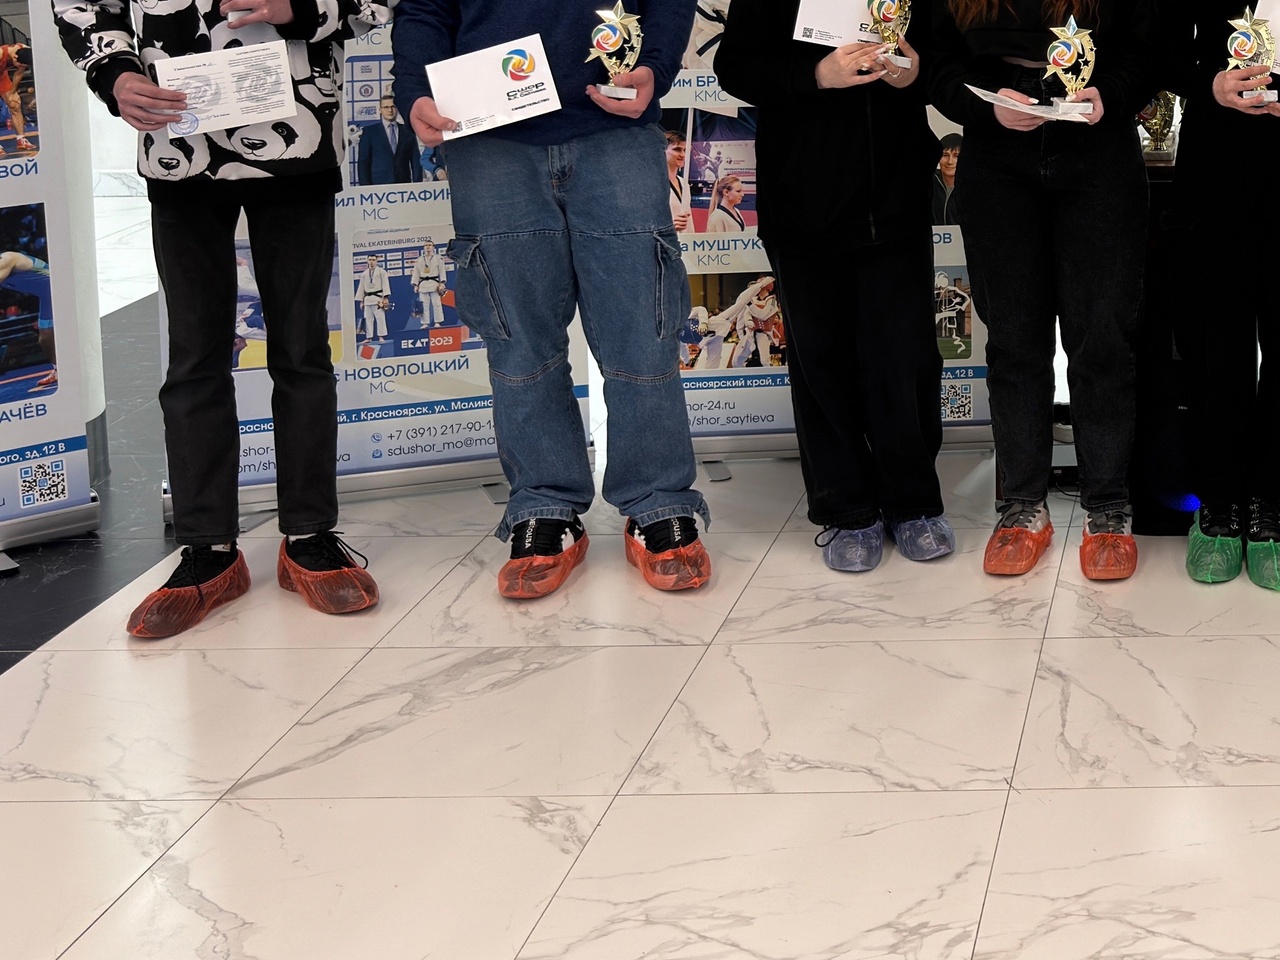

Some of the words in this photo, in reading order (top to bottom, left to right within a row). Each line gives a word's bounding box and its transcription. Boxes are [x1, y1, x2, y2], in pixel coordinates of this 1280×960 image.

[694, 89, 729, 103] КМС
[363, 207, 389, 221] МС
[368, 237, 416, 248] EKATERINBURG
[697, 253, 731, 267] КМС
[401, 338, 429, 350] EKAT
[430, 336, 453, 347] 2023
[344, 355, 470, 382] НОВОЛОЦКИЙ
[370, 380, 396, 395] МС
[746, 376, 775, 387] край,
[360, 405, 432, 422] Красноярск,
[434, 403, 449, 415] ул.
[387, 430, 403, 441] +7
[406, 426, 438, 441] (391)
